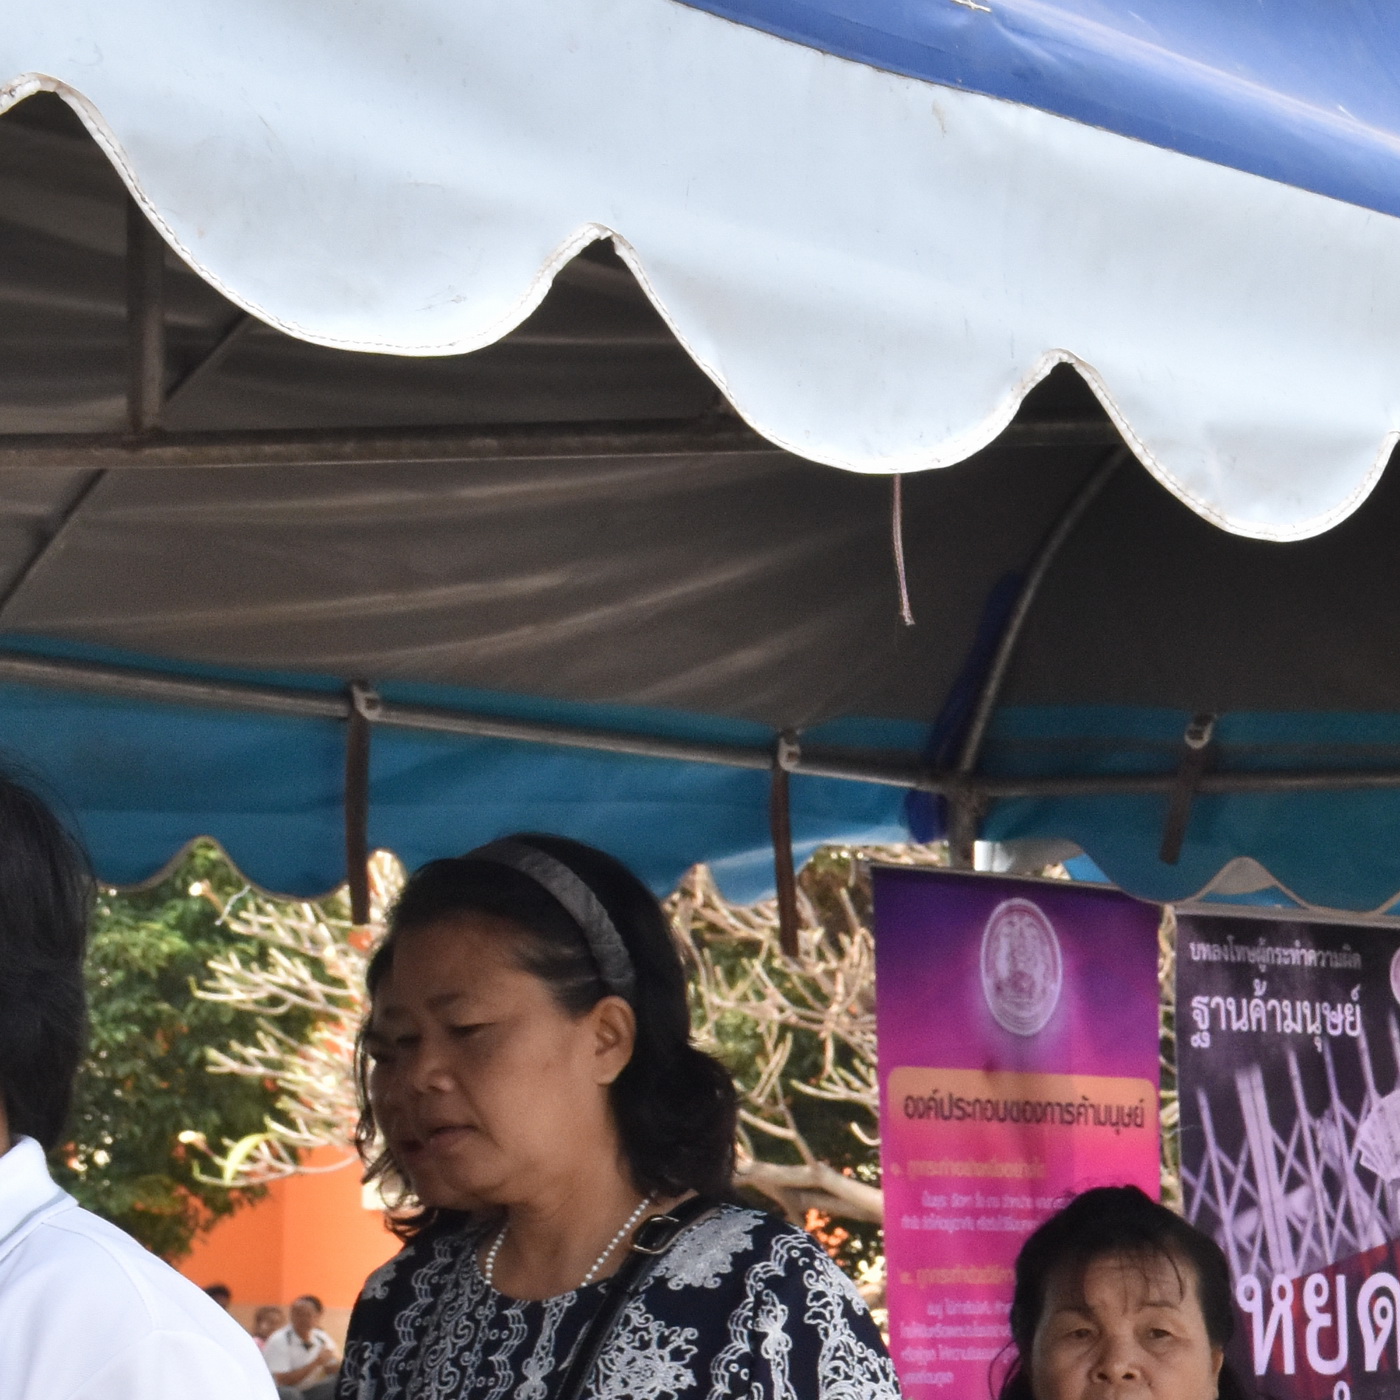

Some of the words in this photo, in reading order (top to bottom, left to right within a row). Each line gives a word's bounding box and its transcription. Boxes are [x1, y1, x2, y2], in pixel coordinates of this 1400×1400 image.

[1190, 978, 1361, 1053] ฐานค้ามนุษย์
[903, 1089, 1145, 1136] องค์ประกอบของการค้ามนุษย์
